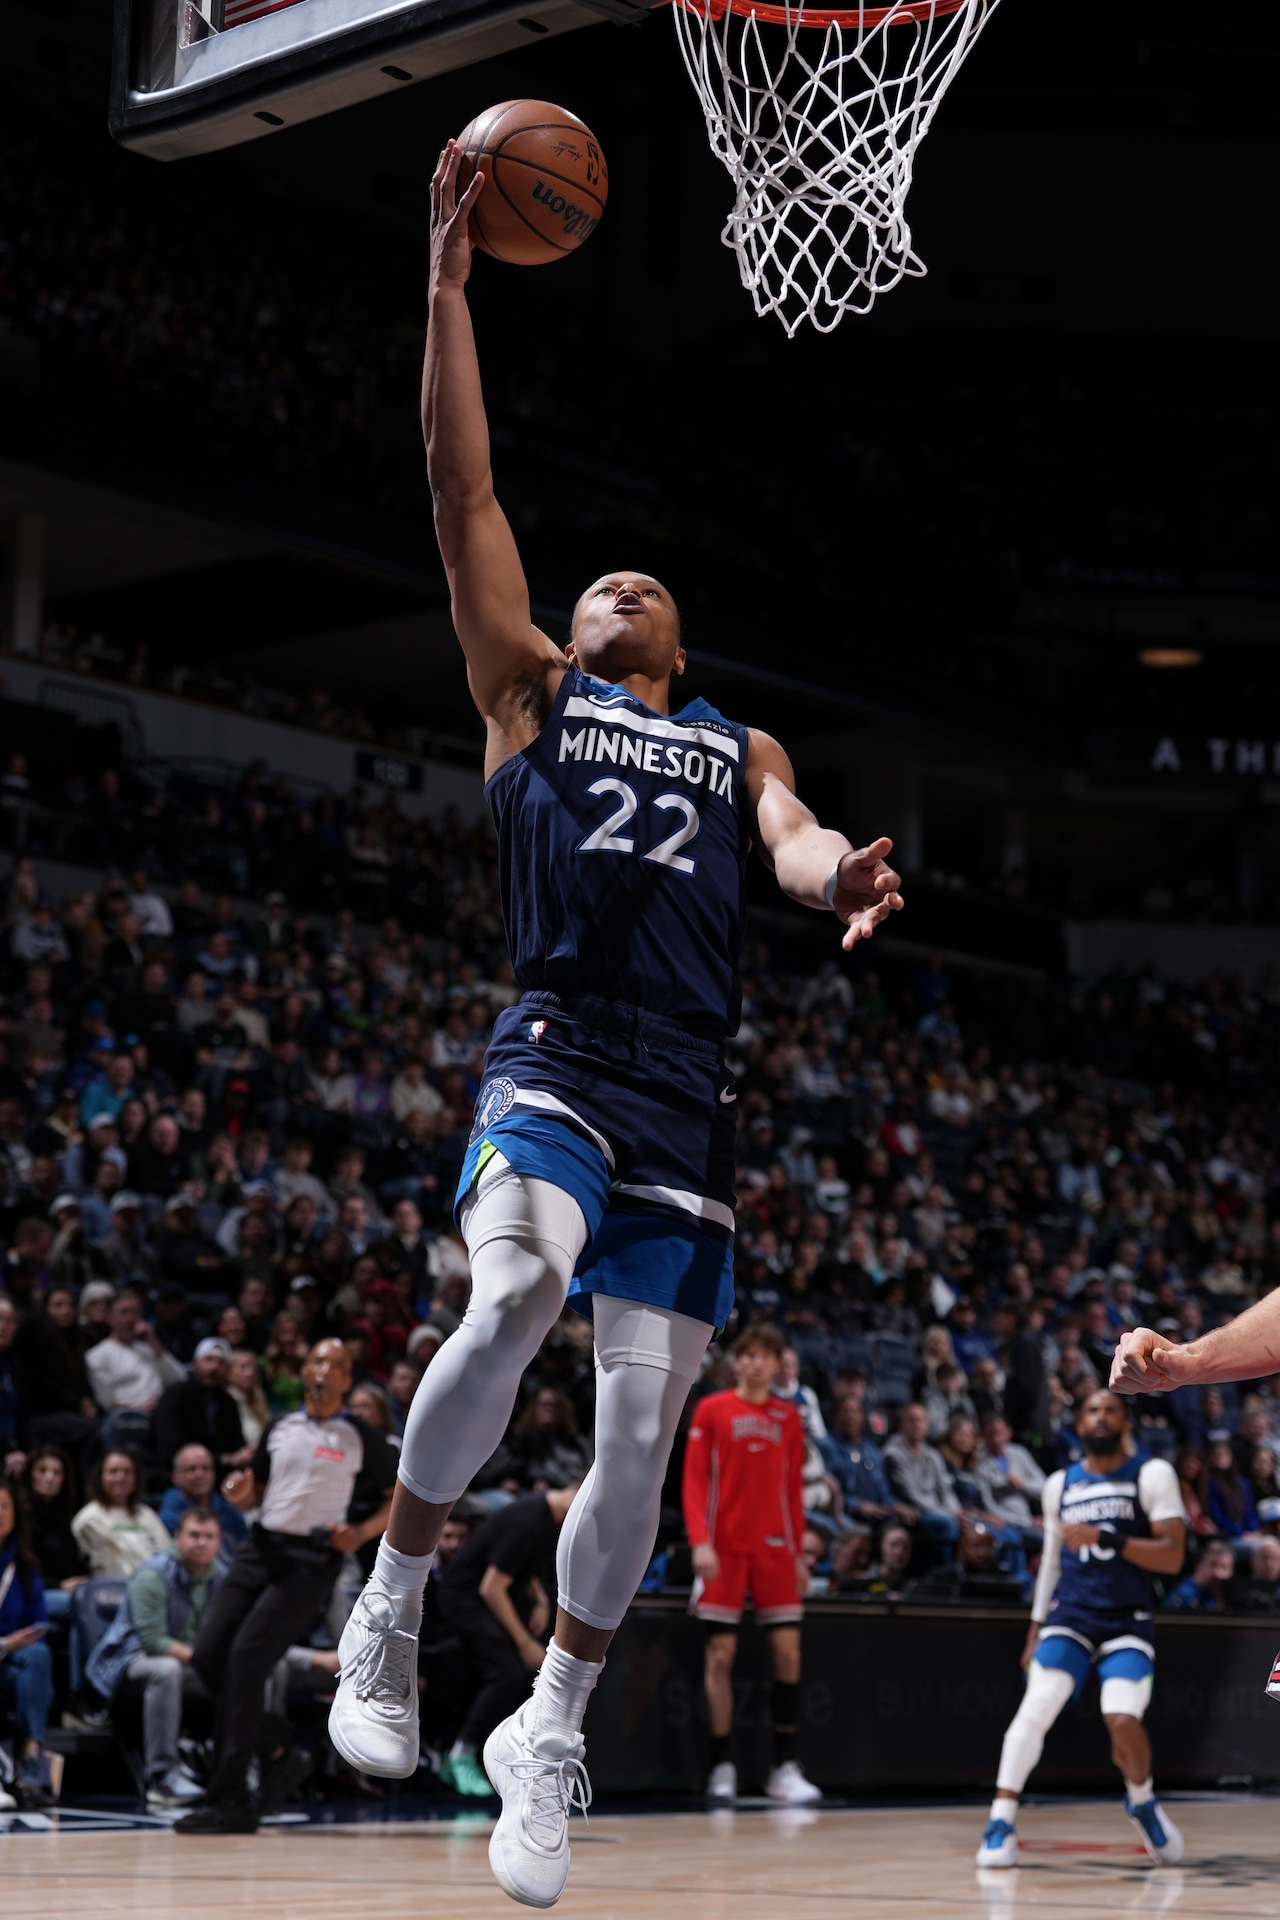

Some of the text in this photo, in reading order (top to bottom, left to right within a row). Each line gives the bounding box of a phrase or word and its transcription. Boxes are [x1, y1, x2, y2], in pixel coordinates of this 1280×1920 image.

[557, 727, 733, 806] MINNESOTA
[1151, 736, 1181, 772] A
[575, 775, 702, 878] 22
[731, 1413, 783, 1446] BULLS
[1060, 1496, 1136, 1524] MINNESOTA
